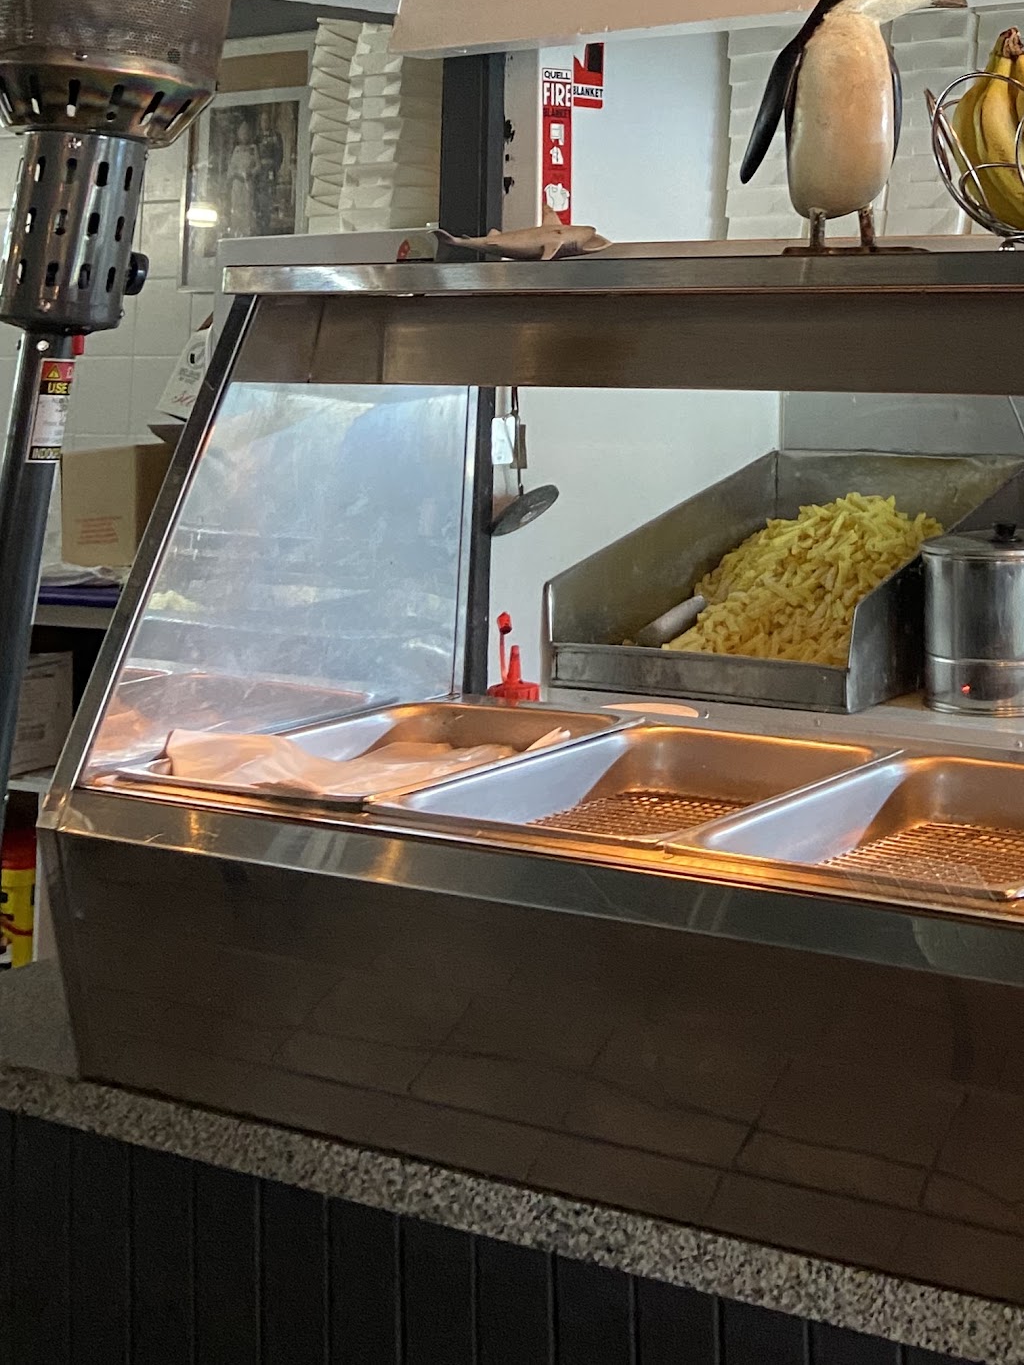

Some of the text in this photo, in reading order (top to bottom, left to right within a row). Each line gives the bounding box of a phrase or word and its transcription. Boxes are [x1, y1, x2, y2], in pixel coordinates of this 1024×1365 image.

[544, 70, 570, 80] QUELL
[543, 82, 571, 107] FIRE
[573, 85, 603, 98] BLANKET
